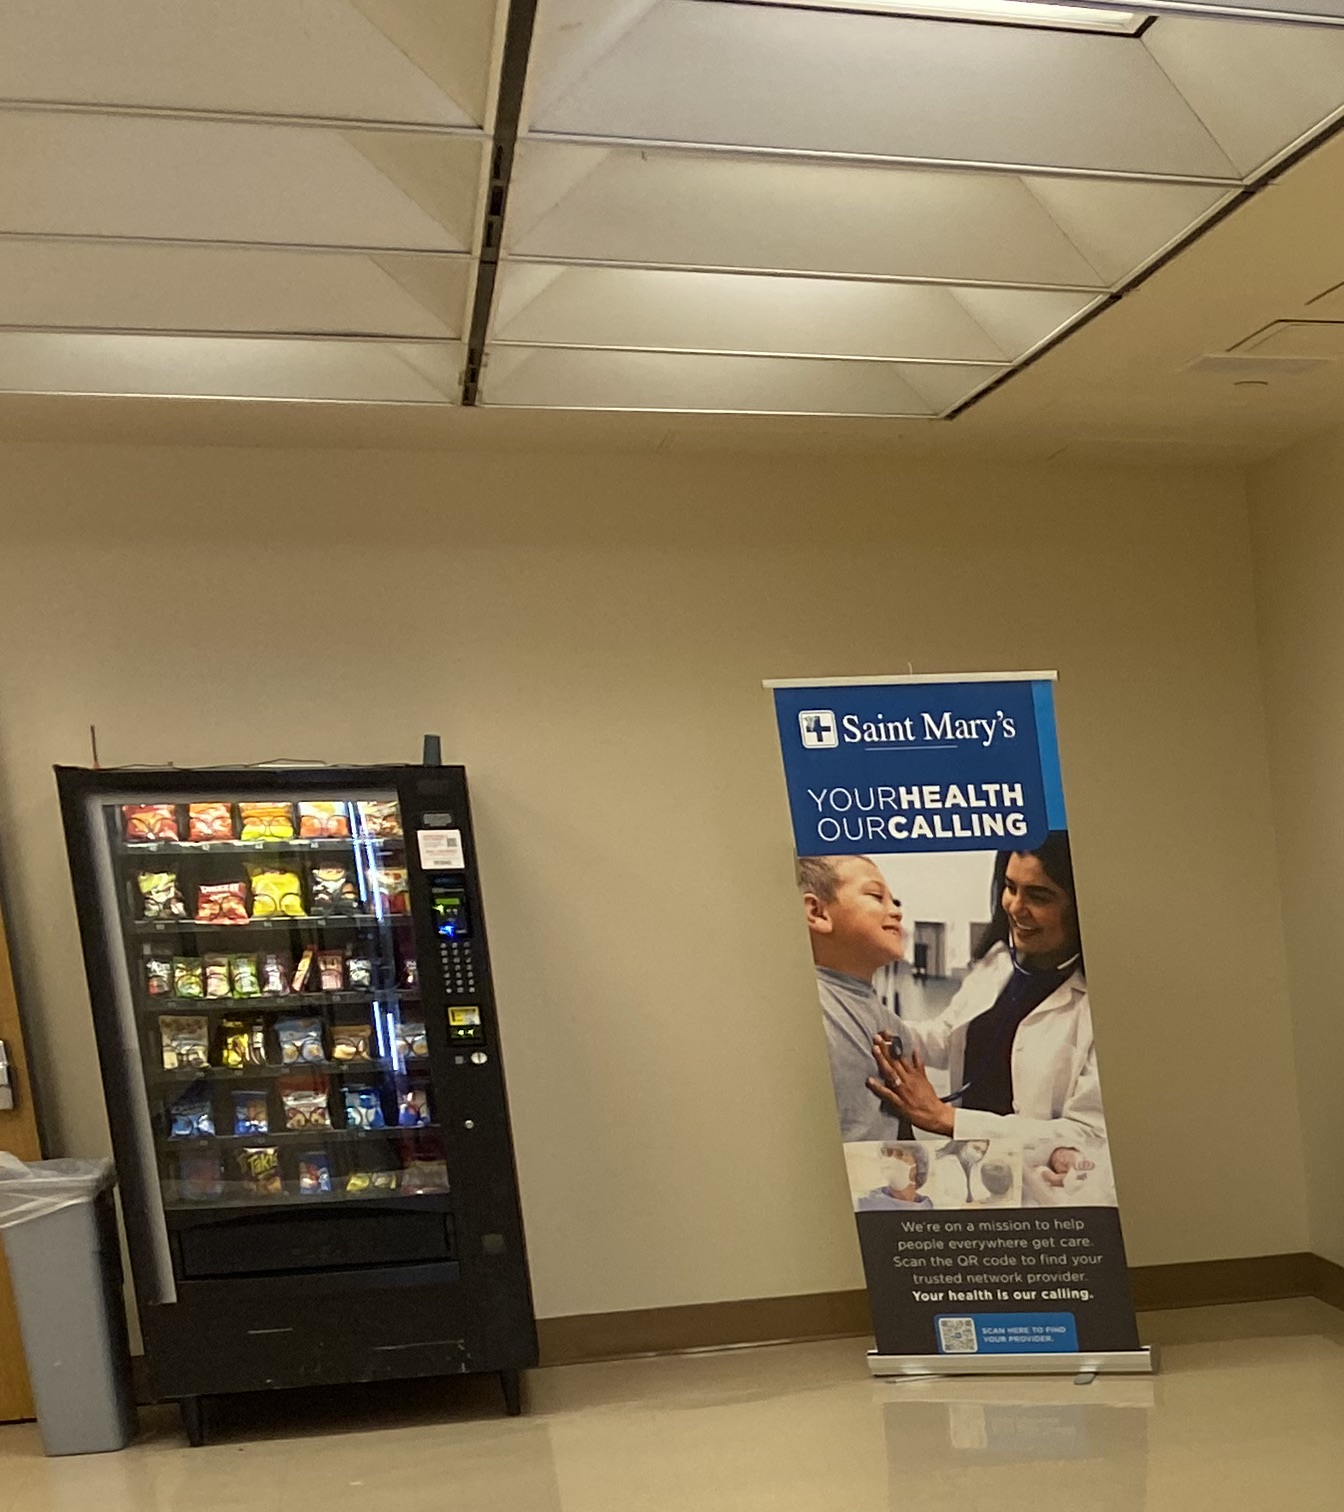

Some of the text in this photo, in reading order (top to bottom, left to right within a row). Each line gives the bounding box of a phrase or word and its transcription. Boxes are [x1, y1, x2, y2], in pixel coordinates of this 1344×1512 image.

[843, 710, 1016, 747] Saint Mary's
[901, 1218, 1084, 1233] We're on a mission to help
[898, 1238, 944, 1251] people
[949, 1238, 1028, 1250] everywhere
[1032, 1237, 1055, 1250] get
[893, 1253, 1103, 1268] Scan the QR code to find your
[913, 1271, 1088, 1285] trusted network provider.
[912, 1288, 1094, 1302] Your health is our calling.
